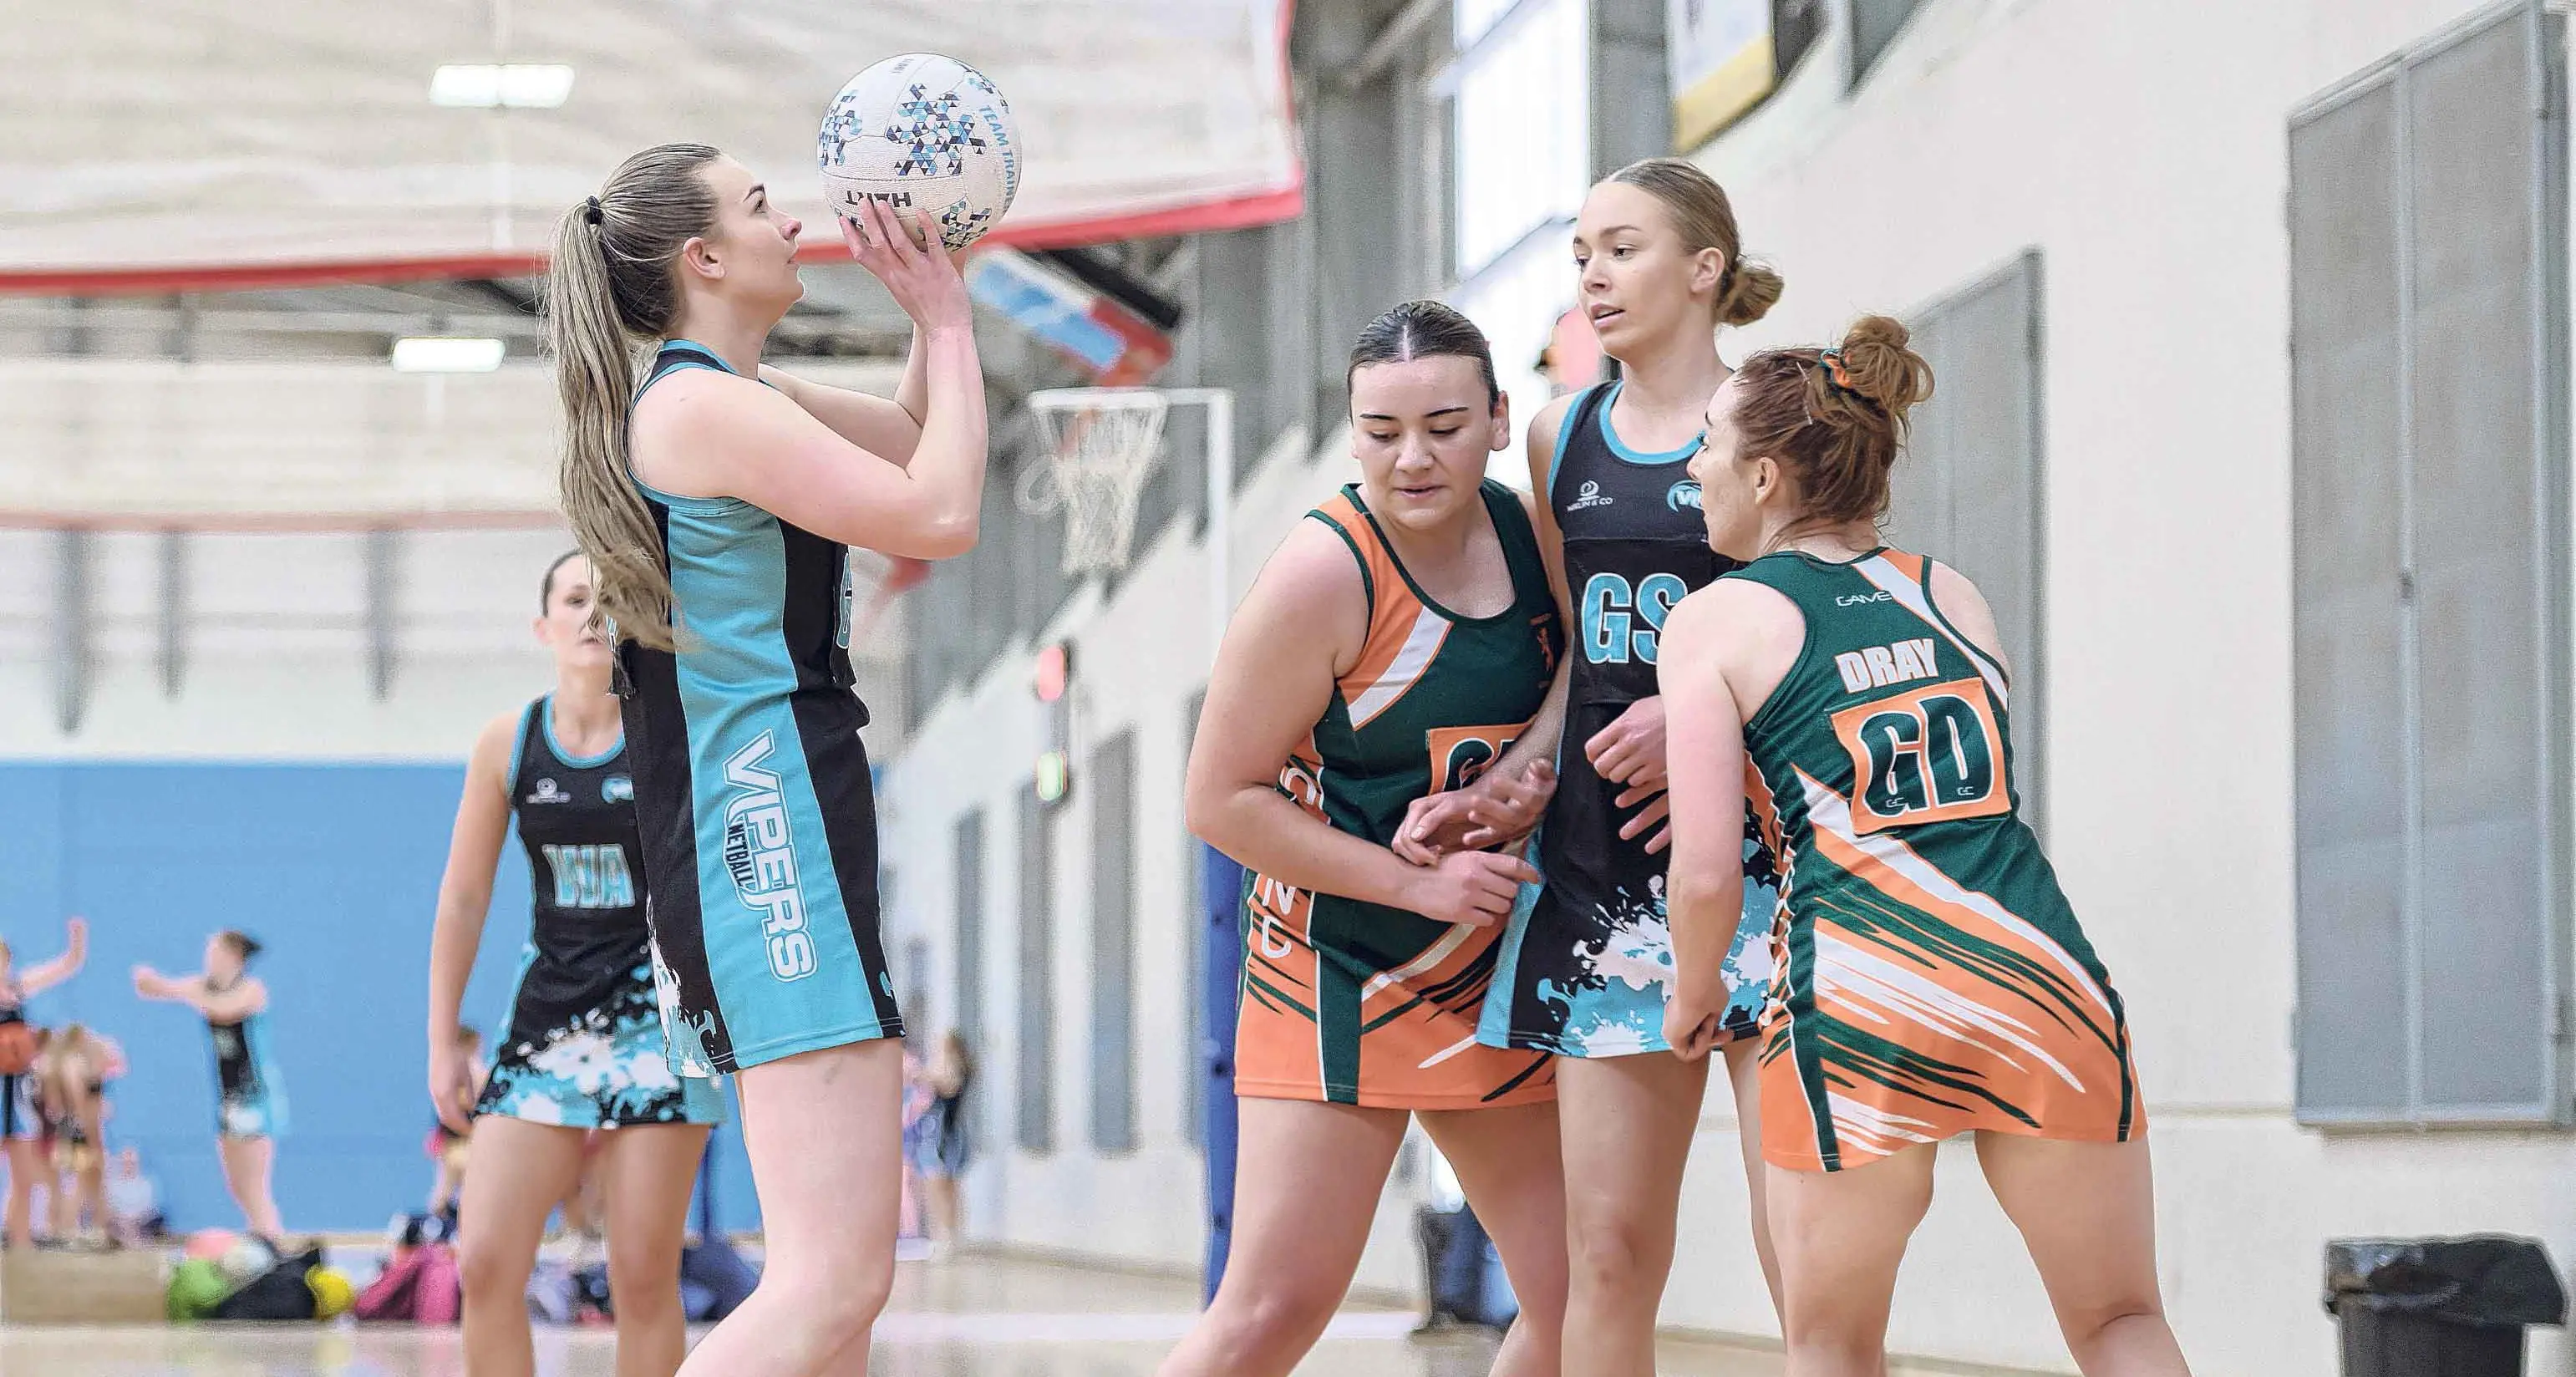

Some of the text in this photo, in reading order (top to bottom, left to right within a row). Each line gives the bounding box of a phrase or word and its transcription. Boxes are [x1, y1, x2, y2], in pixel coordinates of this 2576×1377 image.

[979, 104, 1009, 147] TEAM
[1581, 572, 1689, 665] GS
[1834, 638, 1939, 694] DRAY
[1857, 694, 1994, 818] GD
[722, 728, 819, 983] VIPERS
[727, 823, 753, 887] NETBALL
